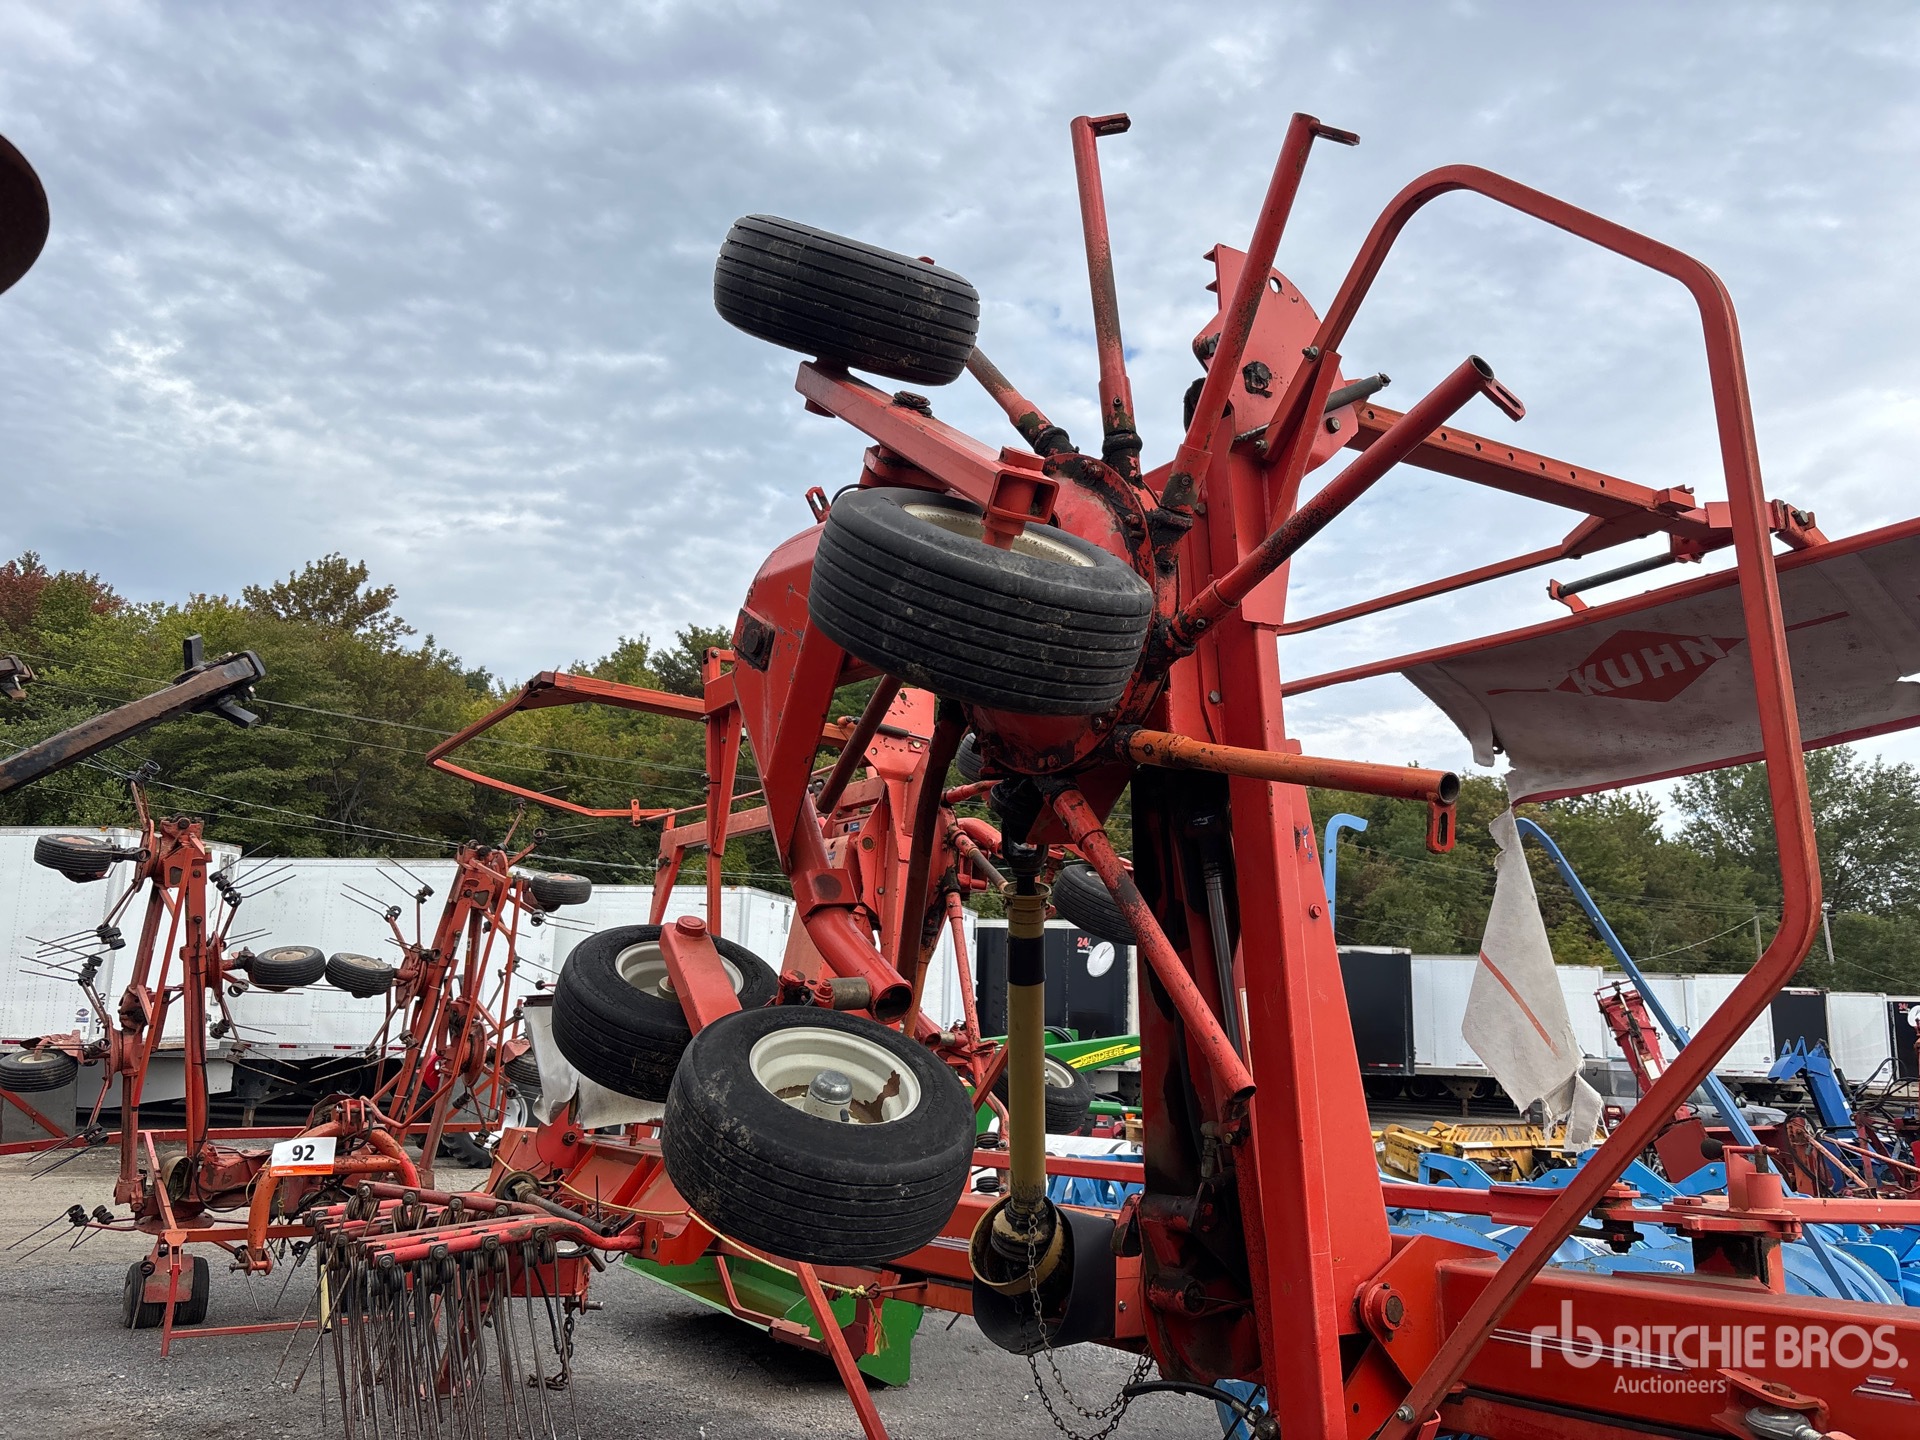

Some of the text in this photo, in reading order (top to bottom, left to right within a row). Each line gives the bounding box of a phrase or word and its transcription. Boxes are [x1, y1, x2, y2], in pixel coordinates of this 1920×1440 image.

[1568, 634, 1729, 696] KUHN
[1080, 1047, 1125, 1066] JOHN DEERE
[292, 1144, 316, 1162] 92
